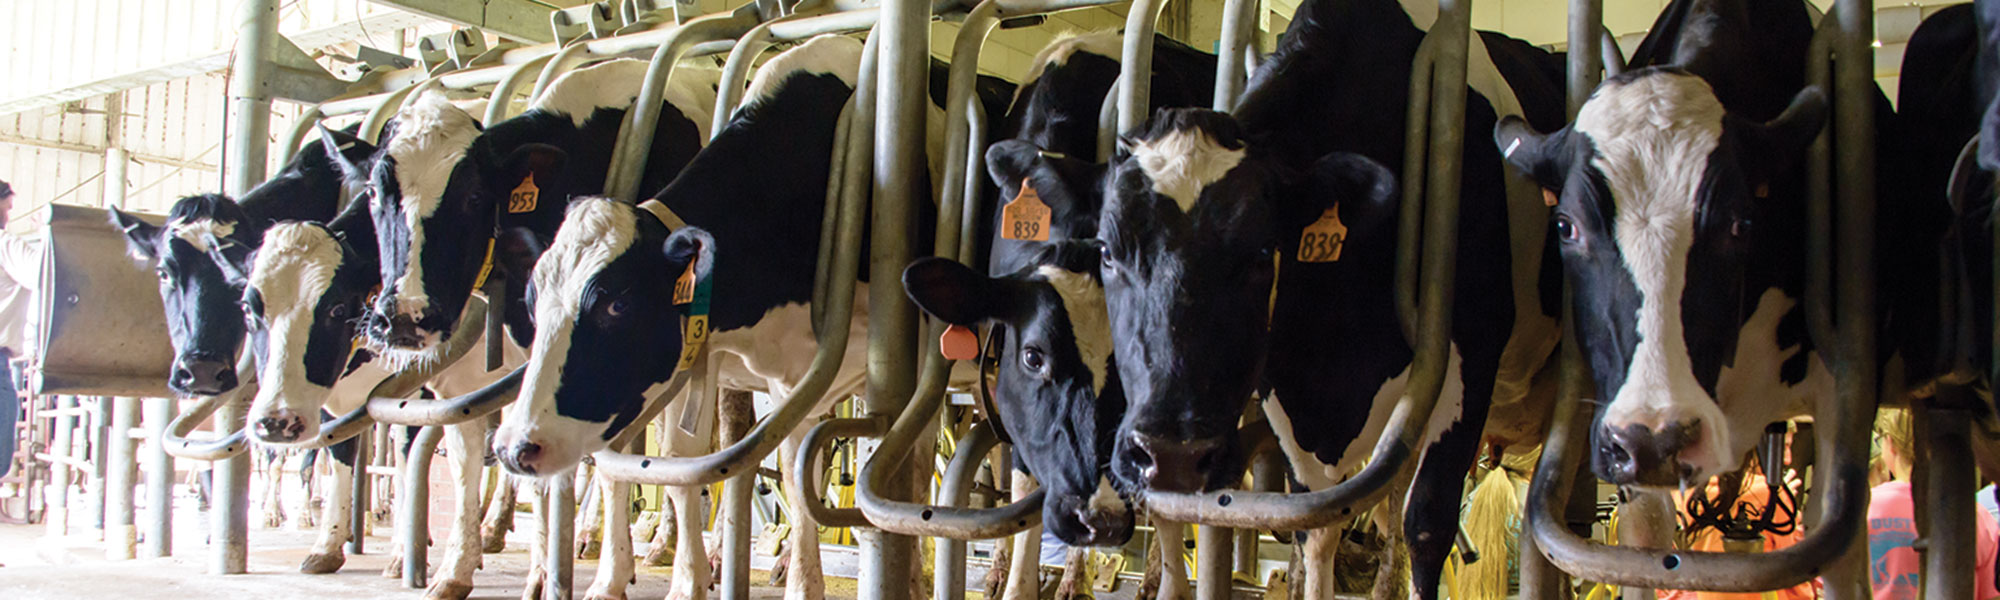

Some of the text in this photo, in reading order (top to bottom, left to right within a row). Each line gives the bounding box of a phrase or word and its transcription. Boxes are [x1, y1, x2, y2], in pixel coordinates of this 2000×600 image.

[512, 192, 535, 210] 953
[1014, 221, 1040, 239] 839
[1301, 232, 1341, 261] 839
[693, 319, 704, 339] 3
